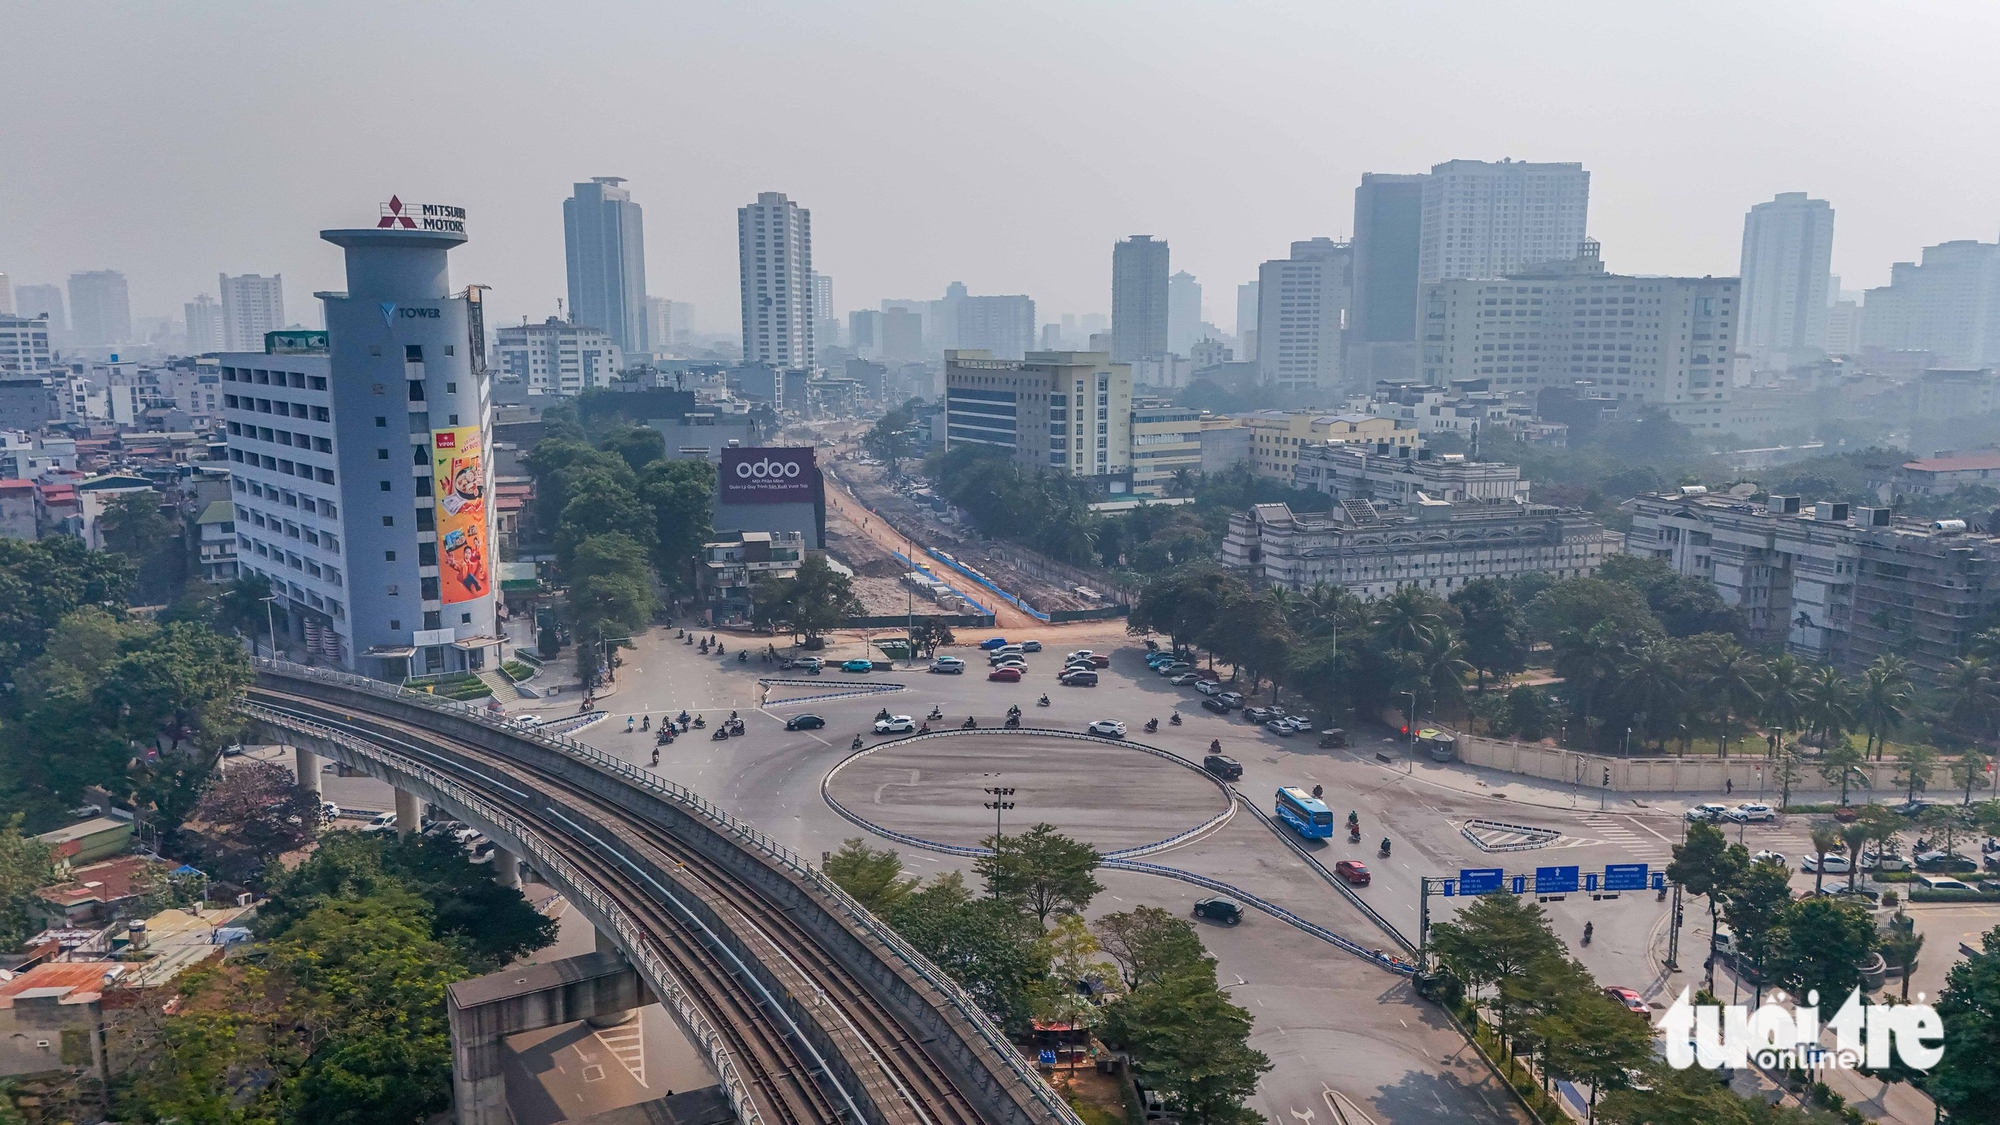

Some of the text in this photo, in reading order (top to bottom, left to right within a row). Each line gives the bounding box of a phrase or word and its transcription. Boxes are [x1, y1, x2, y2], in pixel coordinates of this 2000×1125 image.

[423, 218, 464, 233] MOTORS
[399, 308, 441, 319] TOWER
[736, 457, 800, 478] odoo
